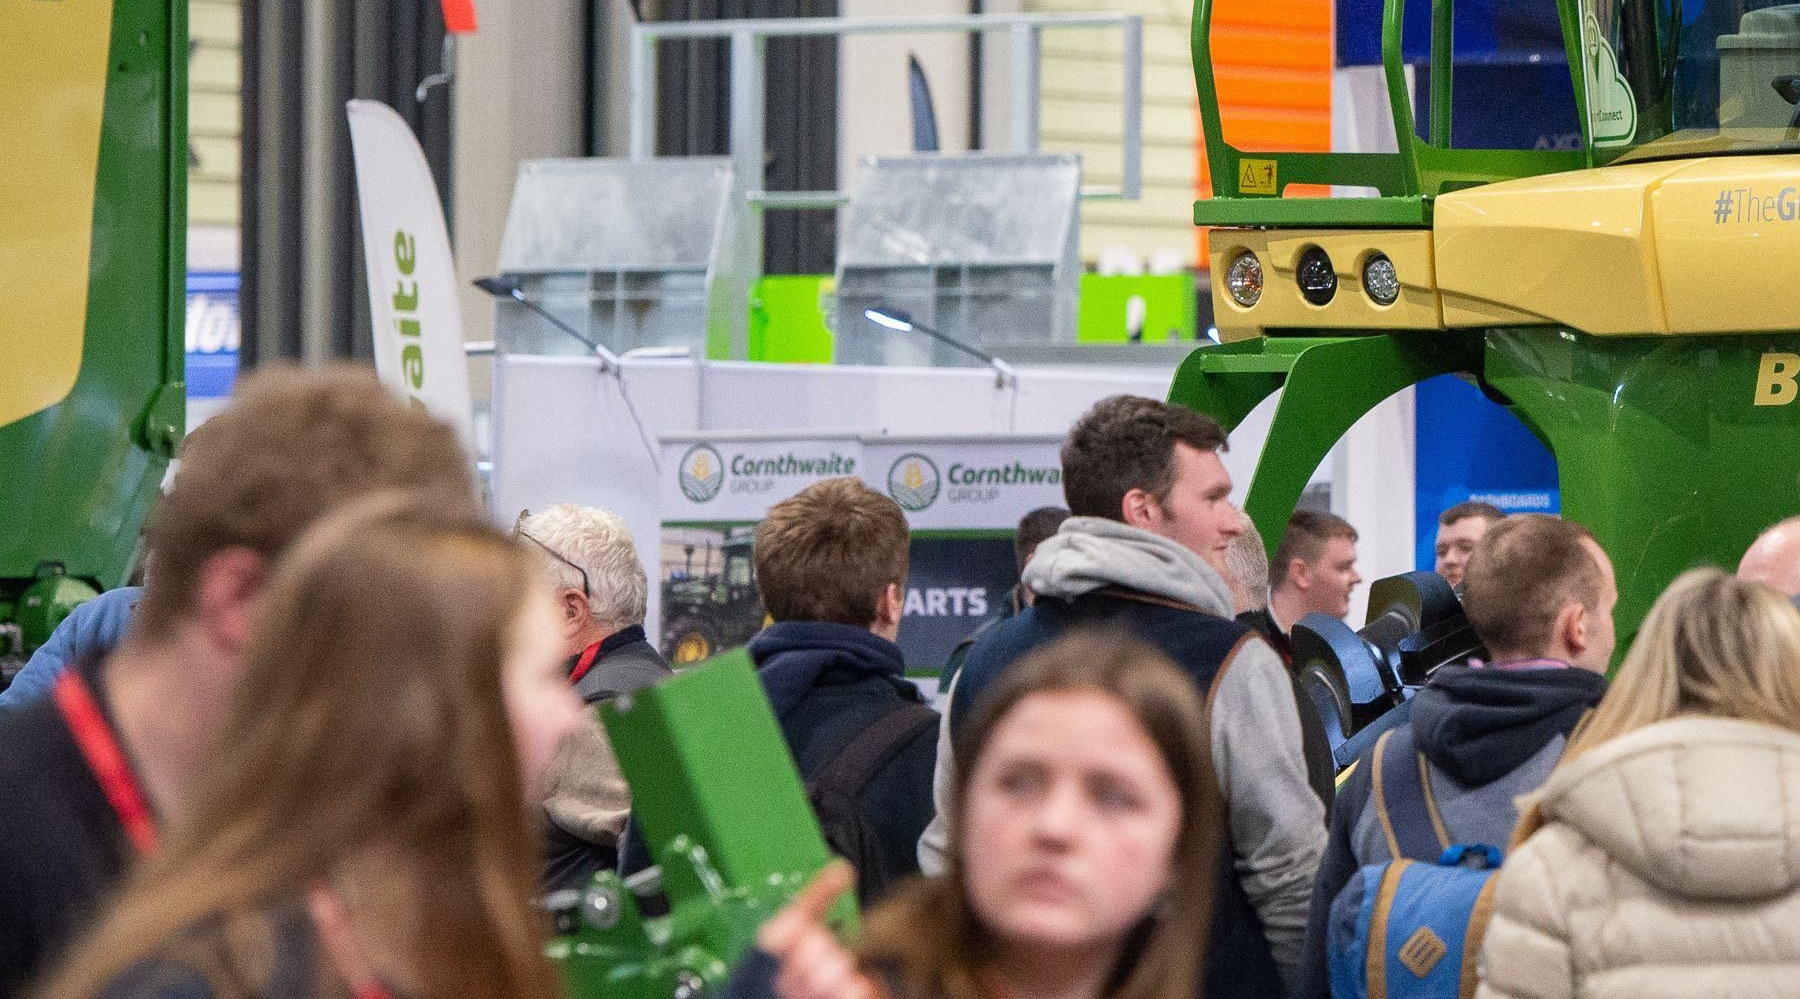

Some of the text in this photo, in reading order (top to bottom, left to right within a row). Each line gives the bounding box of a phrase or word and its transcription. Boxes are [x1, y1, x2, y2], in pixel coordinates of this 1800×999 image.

[393, 229, 426, 414] aite
[730, 451, 857, 476] Cornthwaite
[947, 461, 1062, 486] Cornthwa
[730, 479, 774, 495] GROUP
[947, 487, 999, 503] GROUP
[903, 587, 989, 617] ARTS
